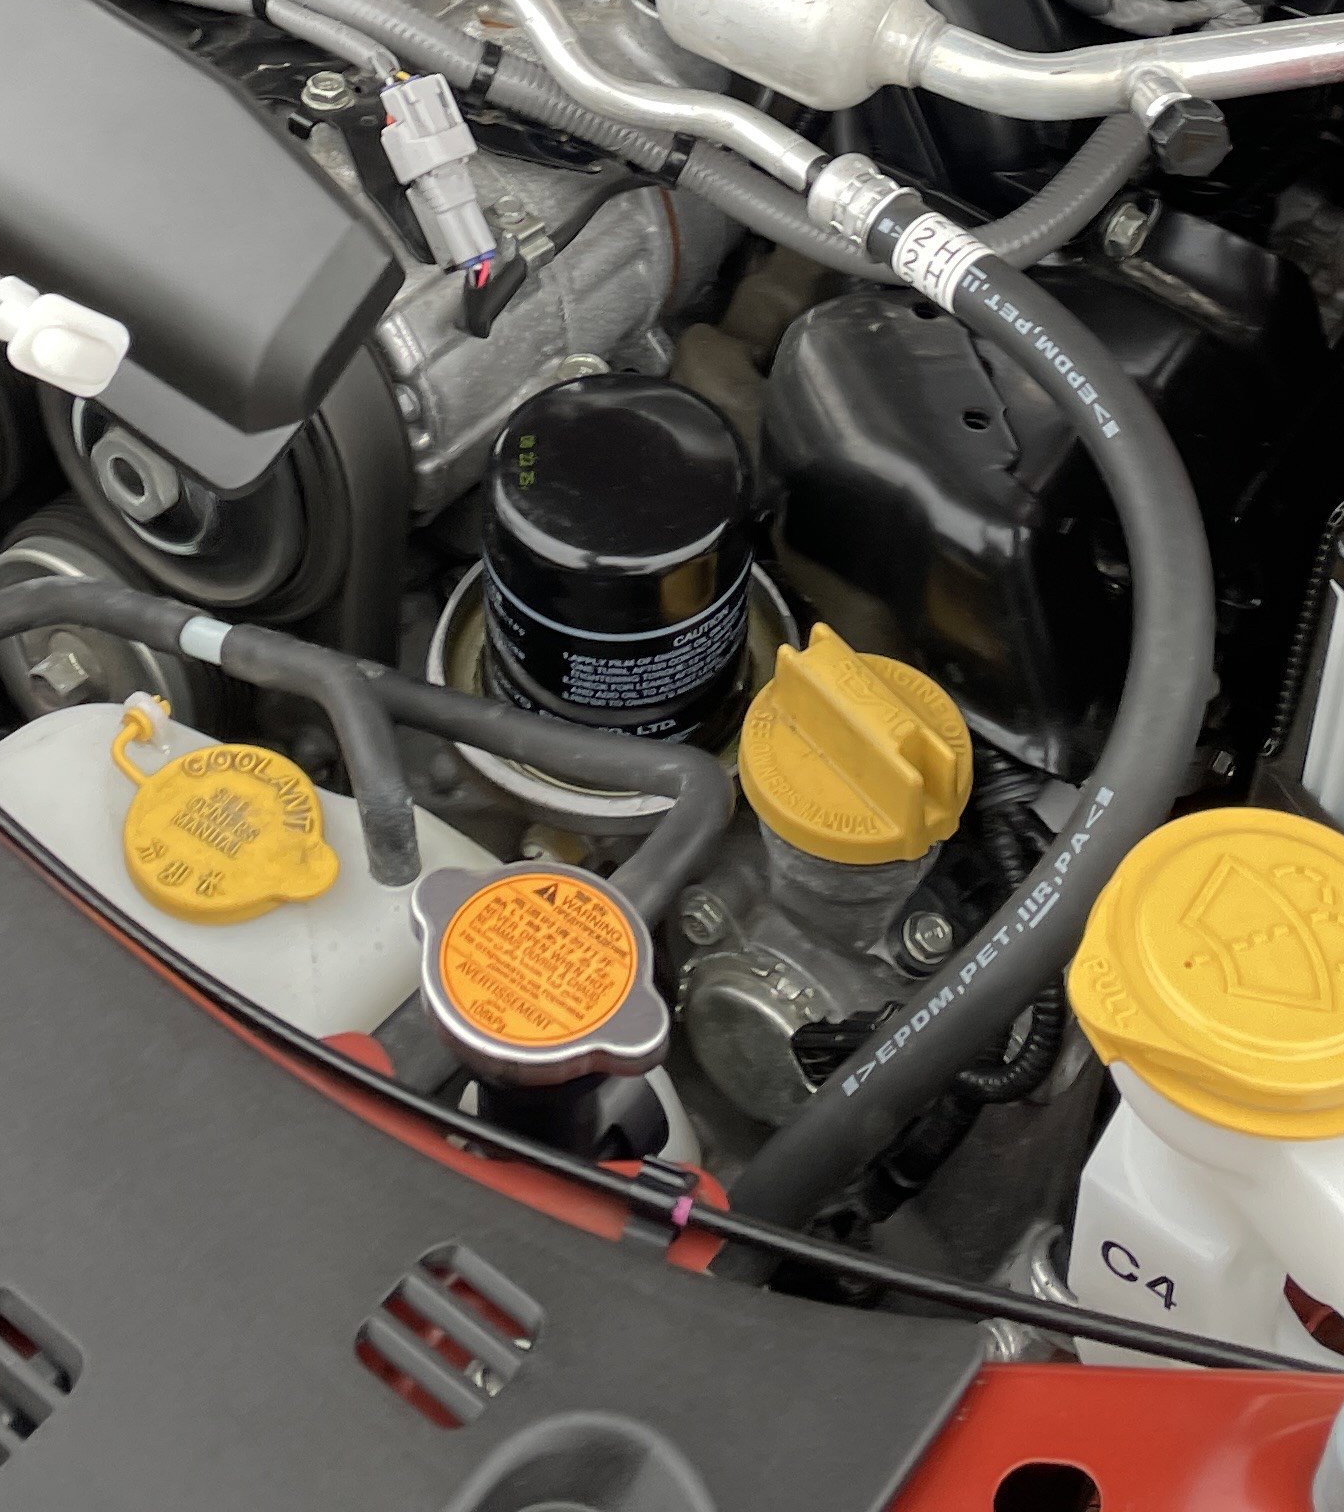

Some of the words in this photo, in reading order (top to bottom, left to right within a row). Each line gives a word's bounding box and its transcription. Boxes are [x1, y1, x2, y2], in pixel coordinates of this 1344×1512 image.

[179, 749, 315, 835] COOLANT
[562, 895, 625, 943] WARNING
[456, 960, 555, 1032] AVERTISSEMENT
[1080, 952, 1138, 1033] PULL
